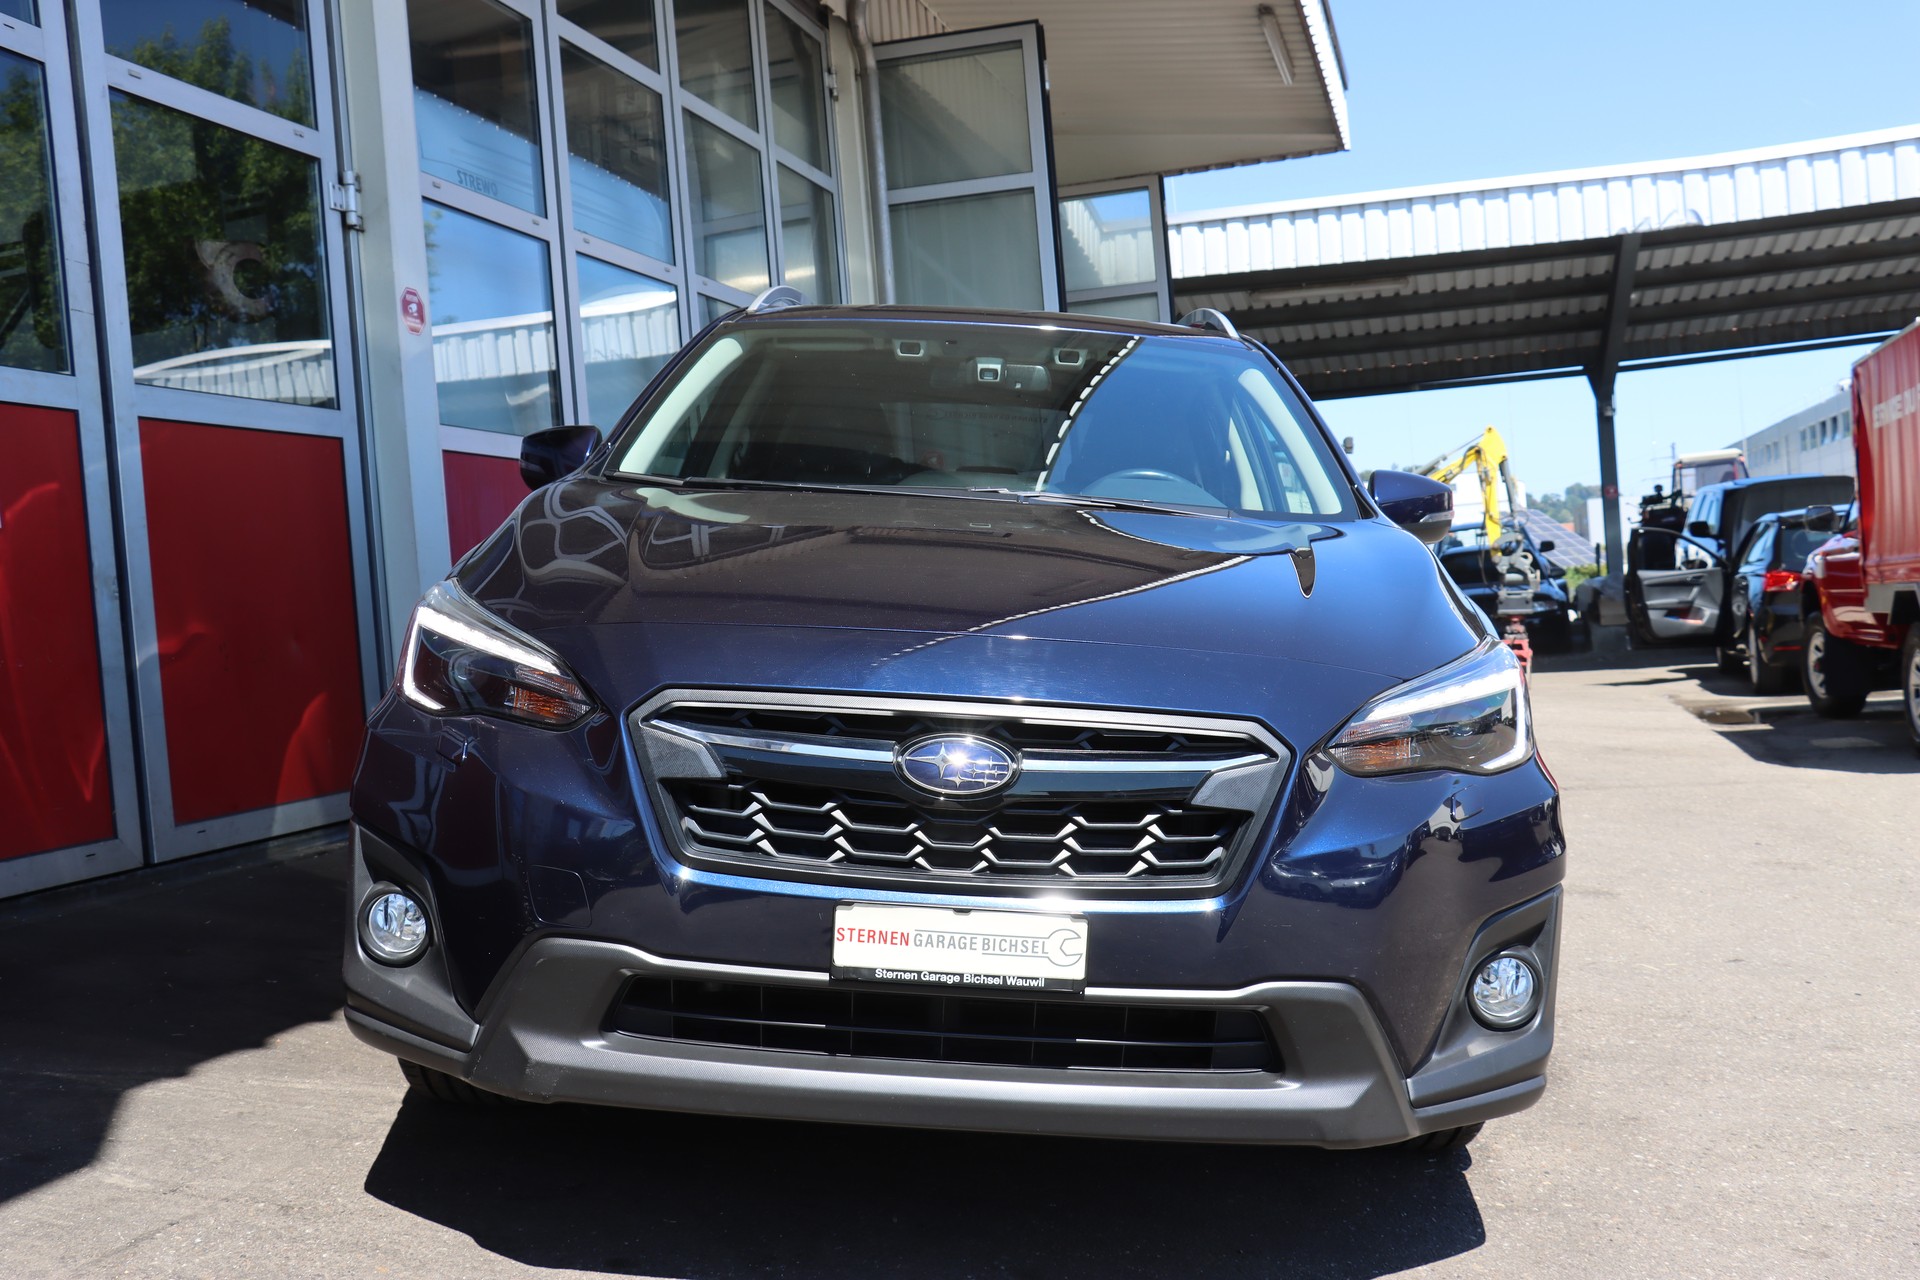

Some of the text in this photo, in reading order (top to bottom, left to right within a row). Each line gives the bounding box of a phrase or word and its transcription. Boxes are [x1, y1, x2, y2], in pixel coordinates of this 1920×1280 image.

[457, 169, 498, 197] STREWO
[836, 927, 1049, 955] STERNEN GARAGE BICHSEL
[875, 968, 1045, 988] Sternen Garage Bichsel Wauwil
